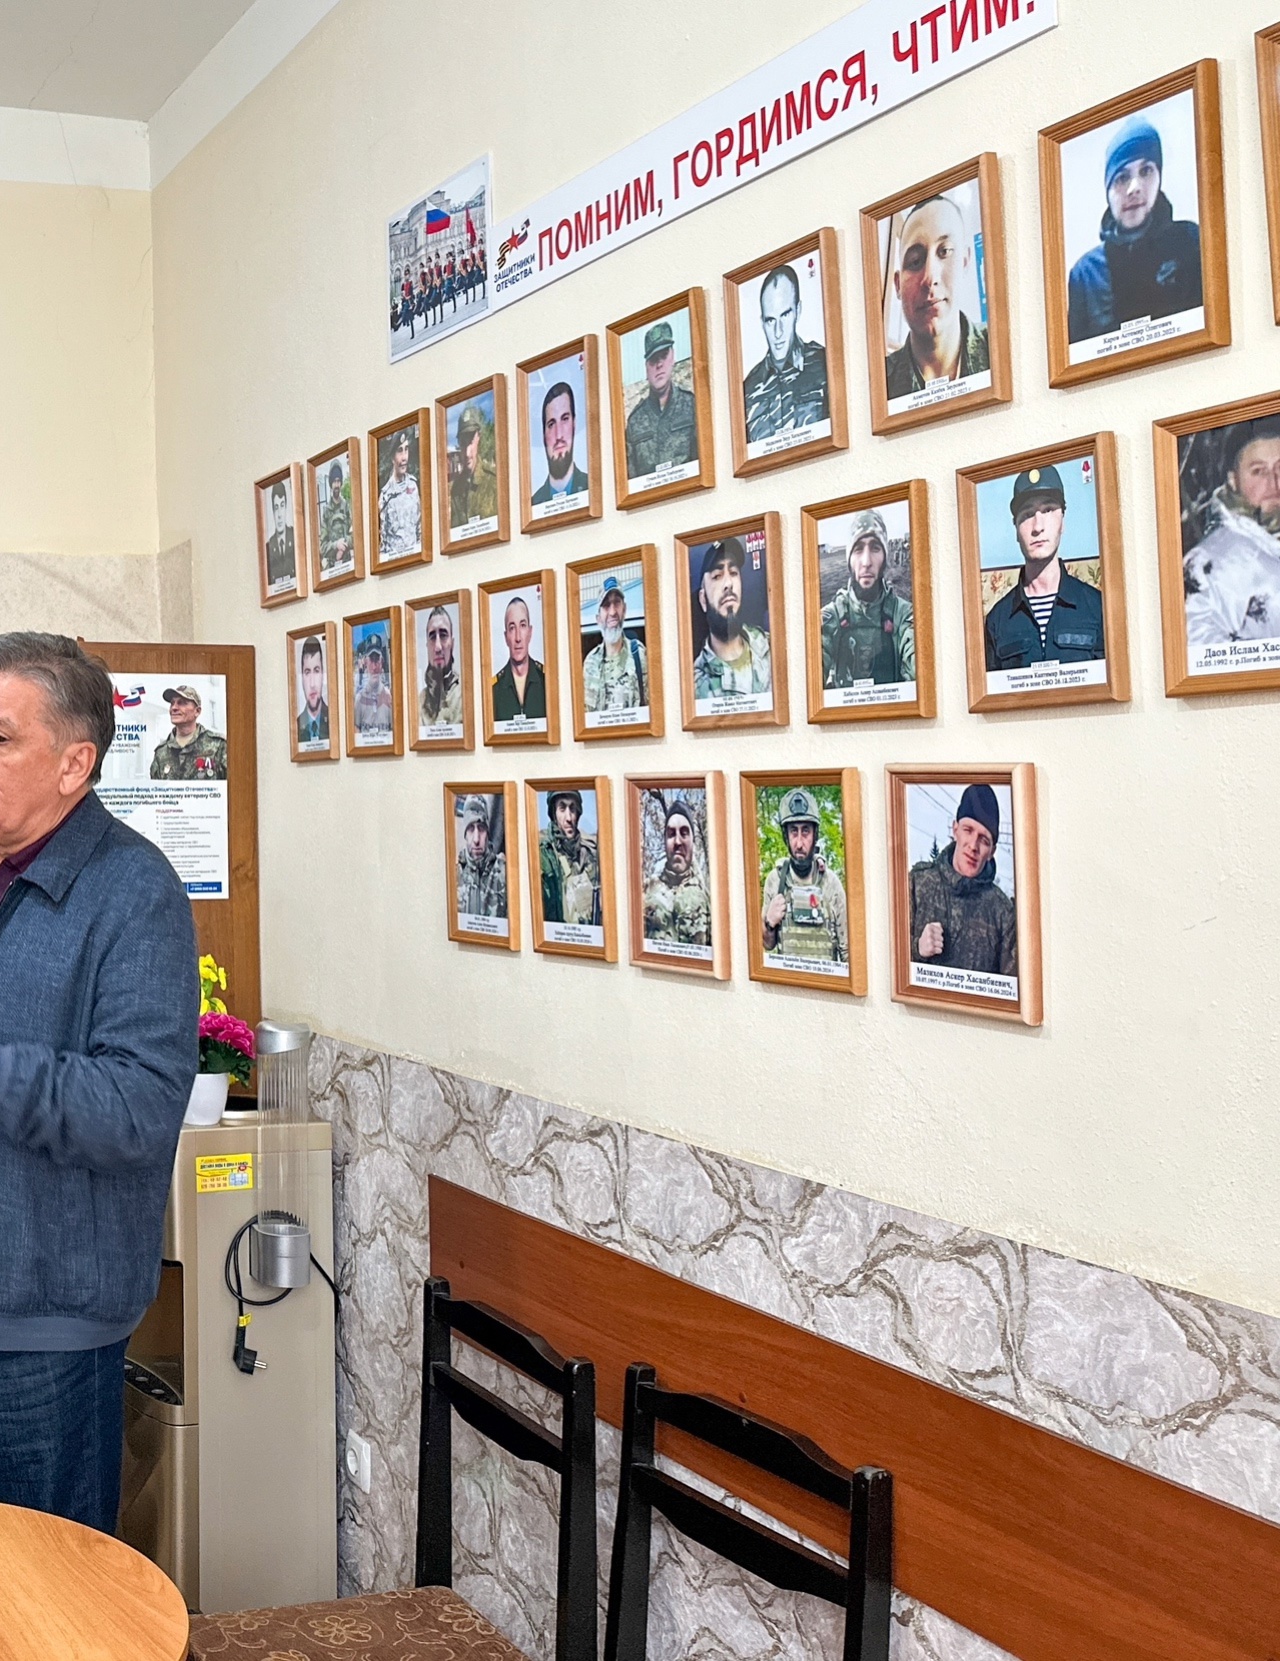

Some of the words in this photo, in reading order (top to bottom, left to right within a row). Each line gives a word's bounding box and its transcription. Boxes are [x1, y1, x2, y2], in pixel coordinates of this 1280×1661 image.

[538, 169, 663, 271] ПОМНИМ,
[673, 50, 879, 199] ГОРДИМСЯ,
[892, 0, 1034, 74] ЧТИМ
[494, 253, 536, 283] ЗАЩИТНИКИ
[496, 267, 533, 292] ОТЕЧЕСТВА
[1096, 345, 1112, 354] погиб
[1118, 340, 1130, 348] зоне
[1131, 336, 1145, 346] СВО
[1204, 648, 1227, 659] Даов
[1229, 646, 1259, 655] Ислам
[1262, 643, 1280, 652] Хас
[1196, 658, 1228, 668] 12.05.1992
[1042, 678, 1053, 686] СВО
[115, 724, 147, 732] ТНИКИ
[945, 972, 965, 982] Аскер
